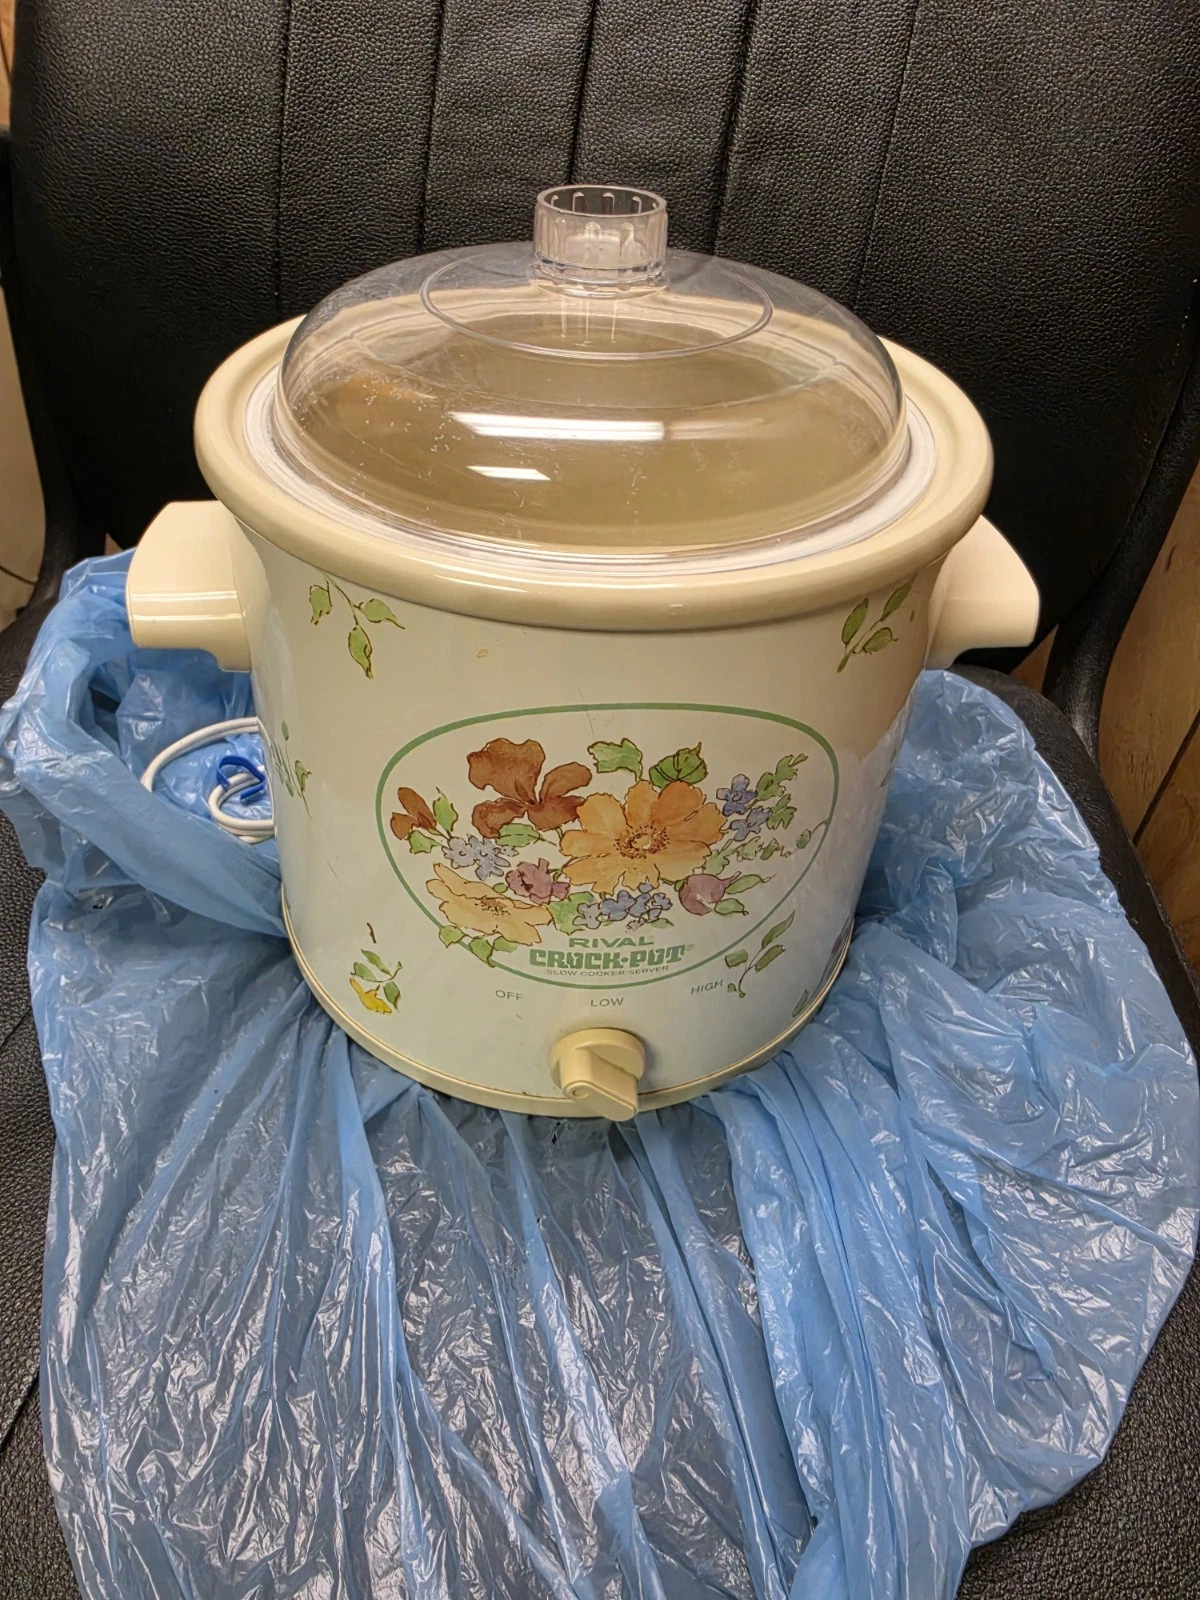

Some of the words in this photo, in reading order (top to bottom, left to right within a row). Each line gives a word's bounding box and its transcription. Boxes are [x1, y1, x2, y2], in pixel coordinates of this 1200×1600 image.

[568, 936, 654, 948] RIVAL
[546, 969, 577, 977] SLOW
[690, 979, 724, 995] HIGH
[495, 989, 523, 1001] OFF
[590, 997, 624, 1007] LOW
